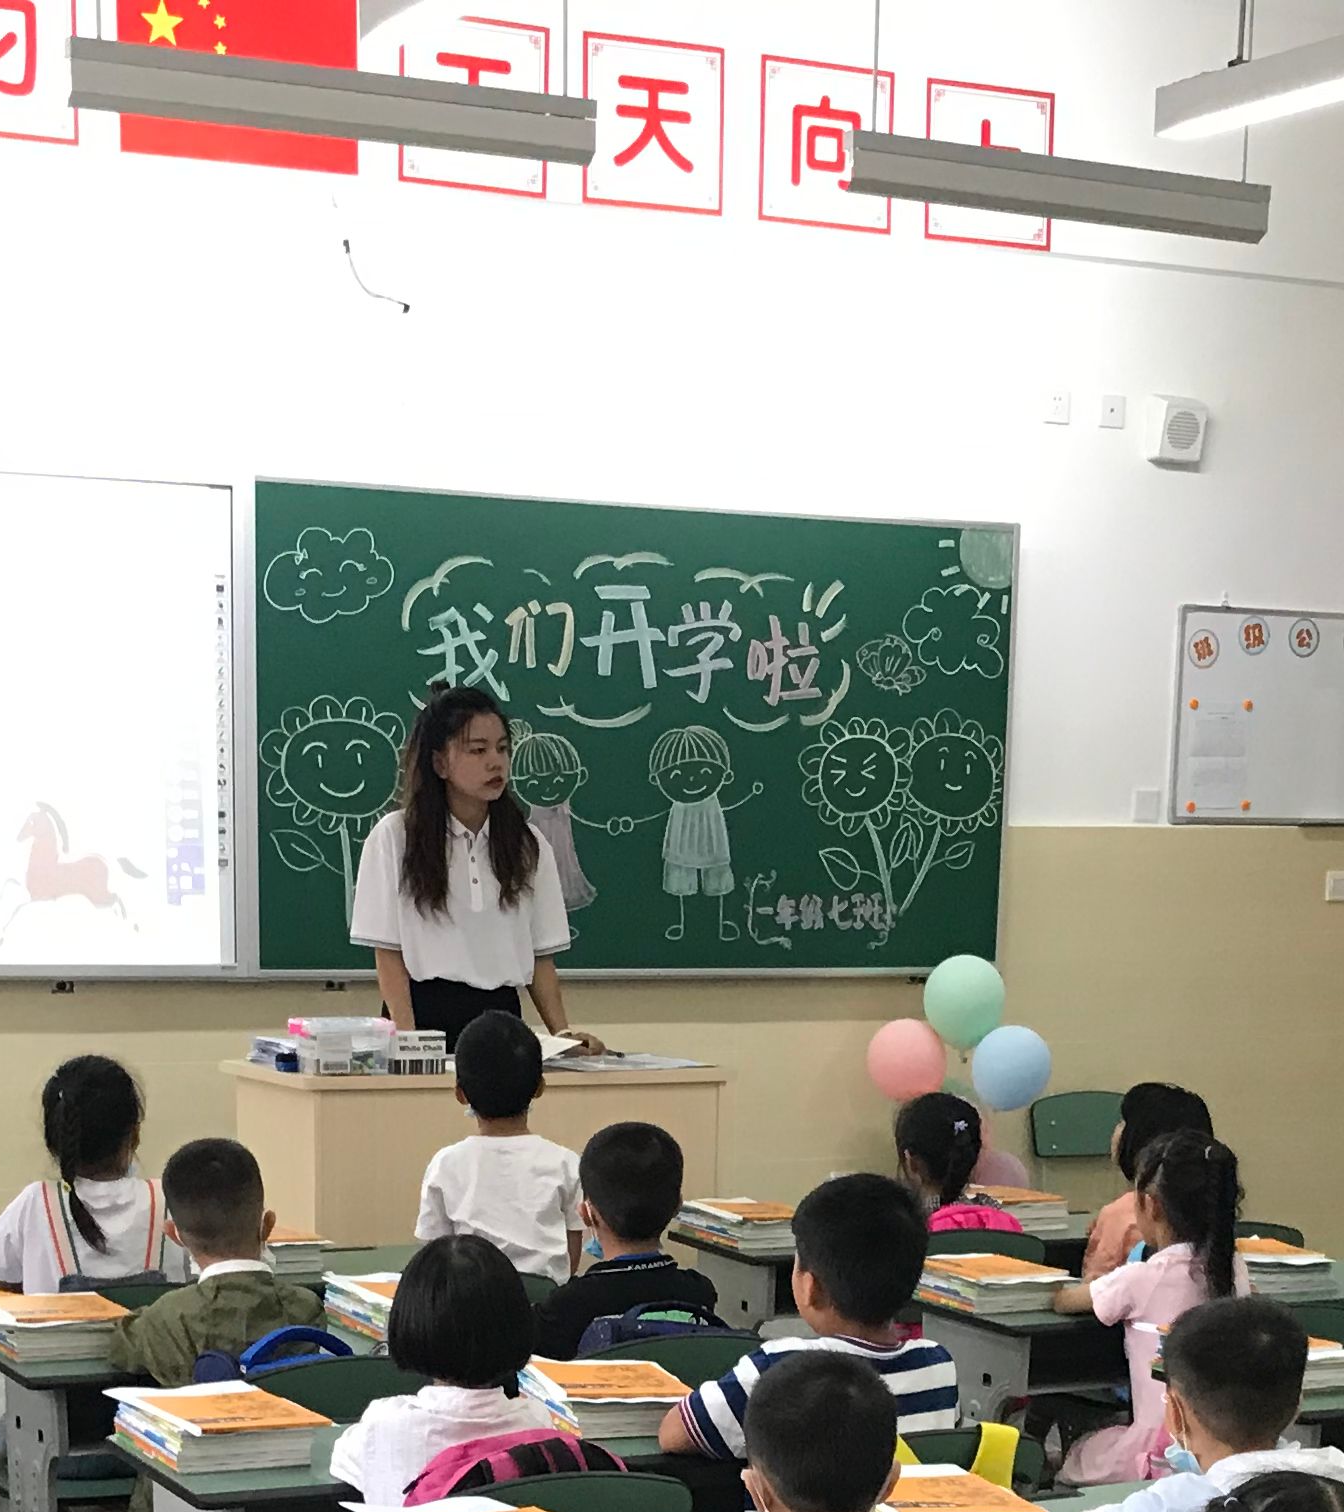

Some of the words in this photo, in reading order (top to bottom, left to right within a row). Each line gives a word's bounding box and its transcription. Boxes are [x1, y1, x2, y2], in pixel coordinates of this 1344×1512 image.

[416, 584, 823, 707] 我们开学啦
[755, 892, 889, 931] 一年级七班
